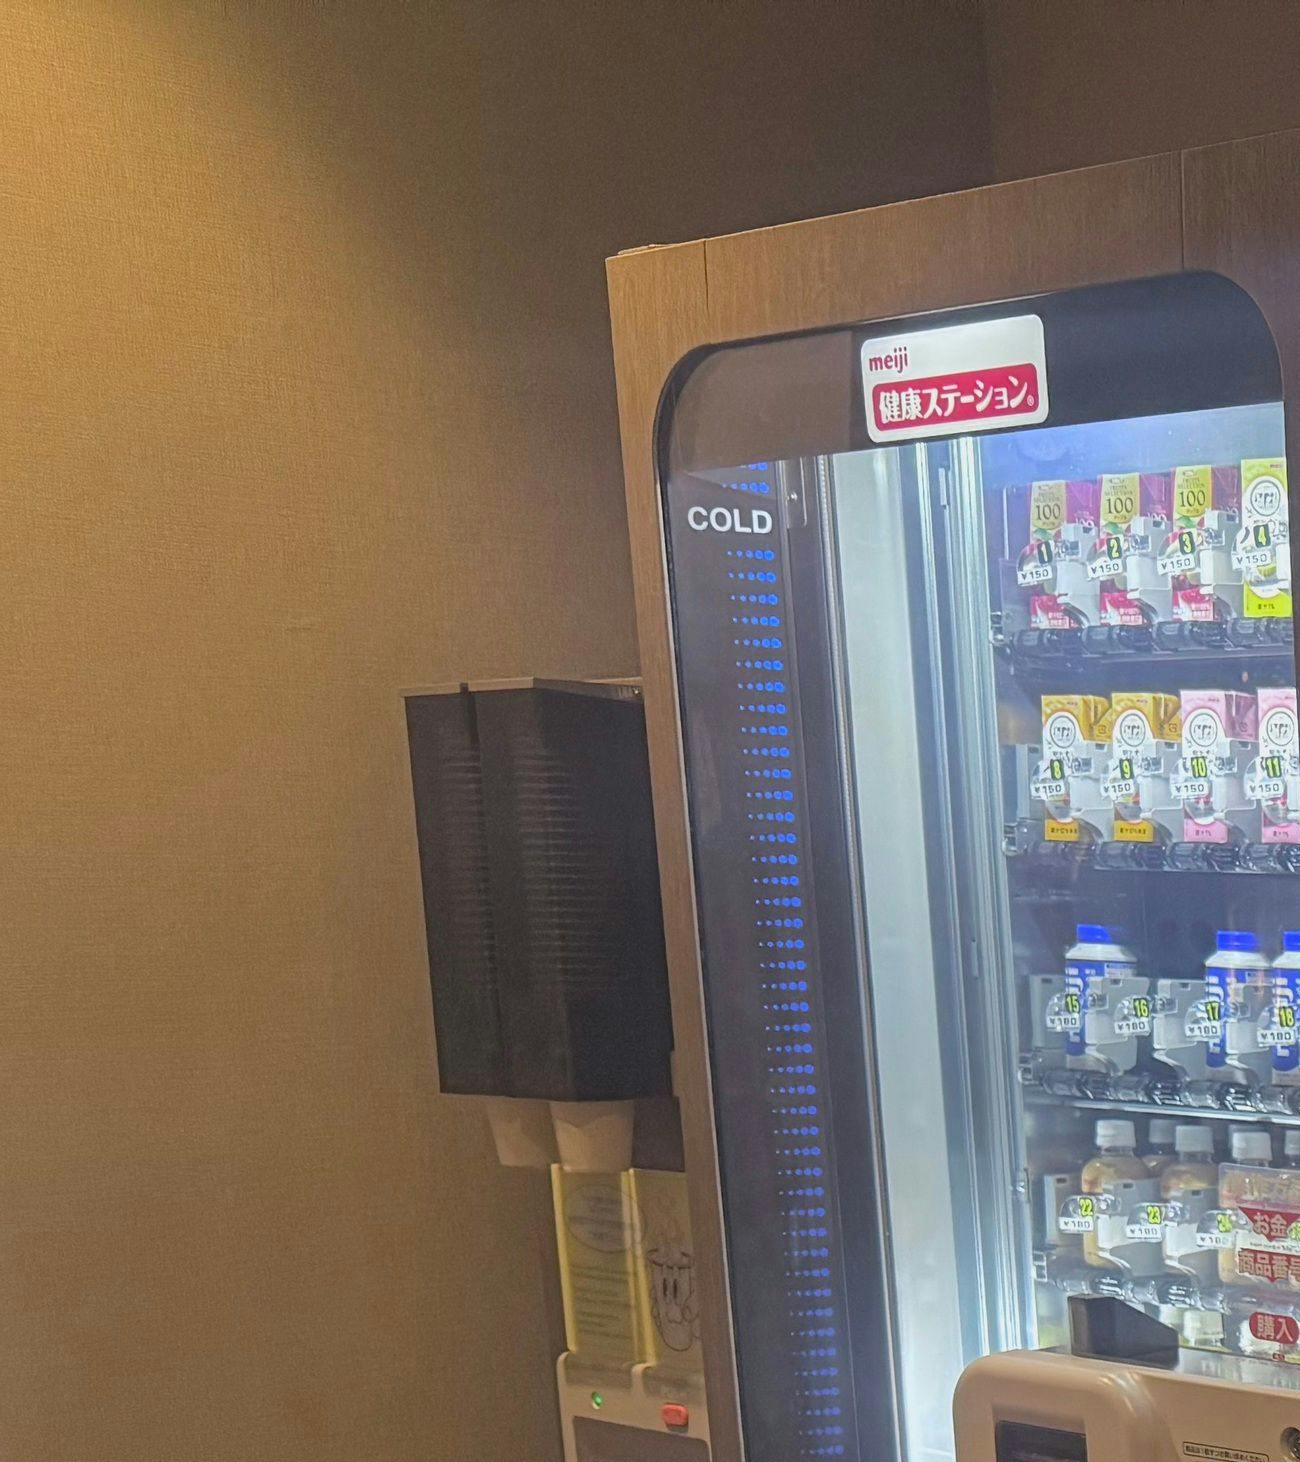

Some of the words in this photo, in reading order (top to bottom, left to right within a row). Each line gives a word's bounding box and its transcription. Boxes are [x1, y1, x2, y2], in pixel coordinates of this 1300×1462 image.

[869, 347, 908, 373] meiji
[879, 376, 1027, 423] 健康ステーション
[1035, 504, 1061, 521] 100
[1107, 498, 1134, 514] 100
[688, 507, 773, 534] COLD
[1182, 533, 1192, 551] 3
[1194, 758, 1206, 776] 10
